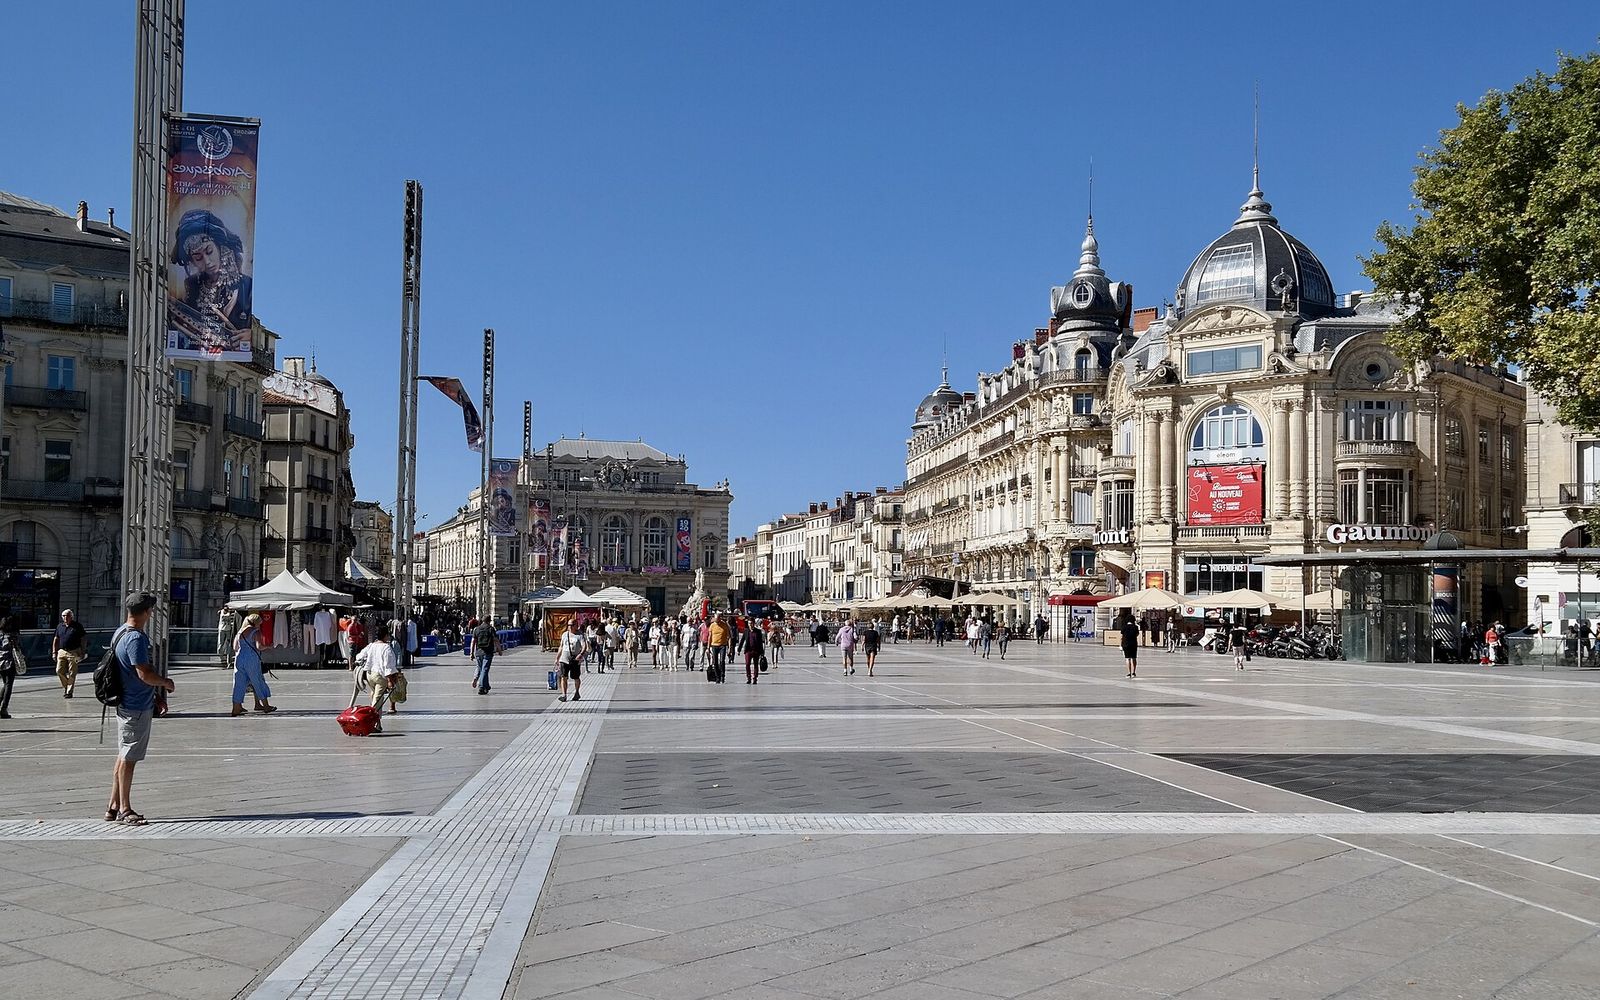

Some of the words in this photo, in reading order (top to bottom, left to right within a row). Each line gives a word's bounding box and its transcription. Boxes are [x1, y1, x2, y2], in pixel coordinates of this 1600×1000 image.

[1218, 490, 1243, 498] NOUVEAU
[1326, 524, 1436, 544] Gaumon
[1071, 568, 1093, 576] CIC
